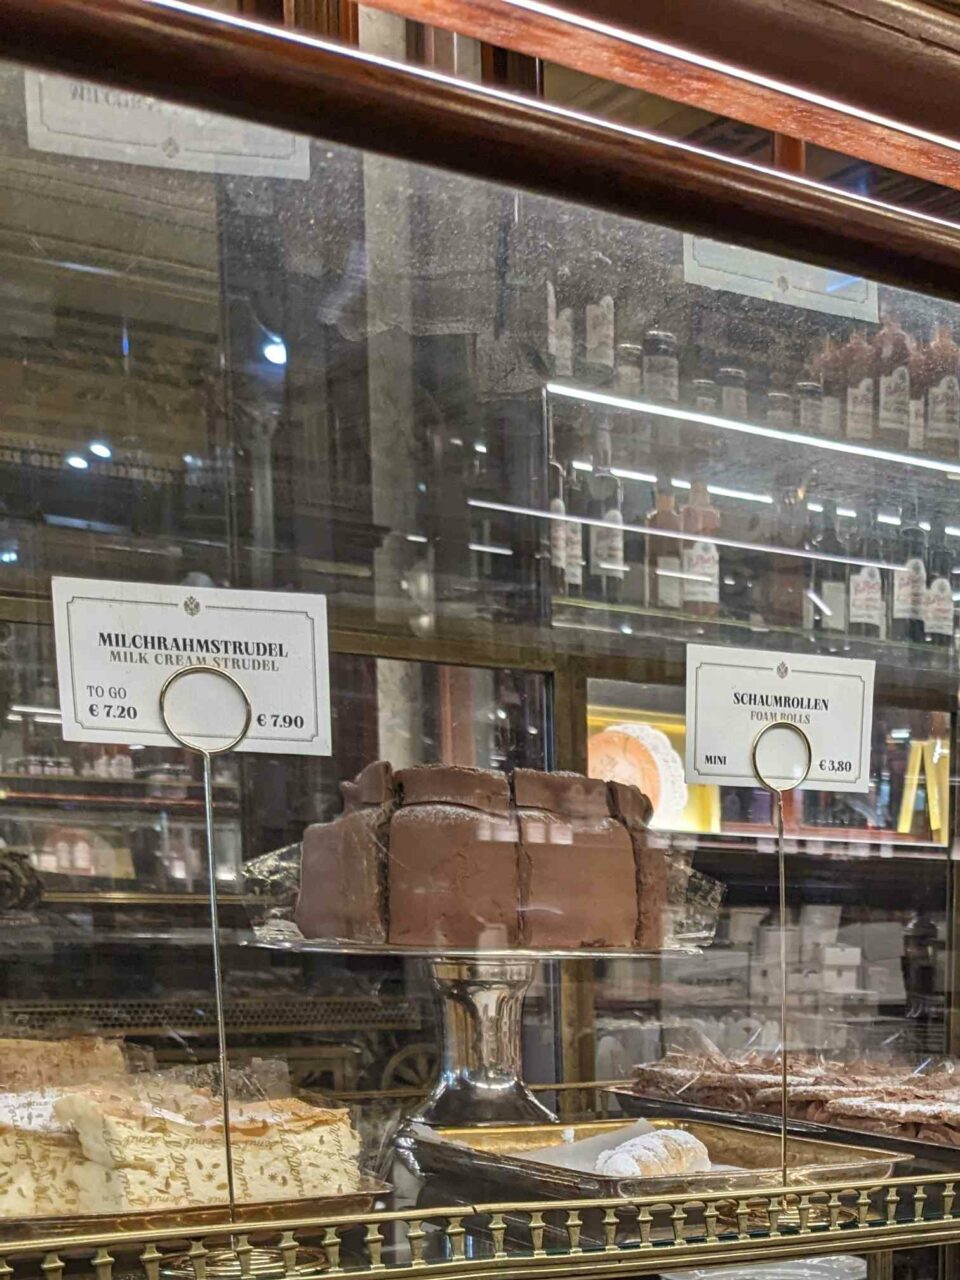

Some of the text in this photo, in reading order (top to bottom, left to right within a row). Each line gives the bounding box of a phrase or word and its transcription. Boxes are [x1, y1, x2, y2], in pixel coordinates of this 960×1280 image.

[98, 632, 289, 658] MILCHRAHMSTRUDEL
[109, 650, 280, 672] MILK CREAM STRUDEL
[86, 685, 127, 700] TO GO
[733, 692, 829, 711] SCHAUMROLLEN
[88, 704, 138, 720] € 7.20
[750, 711, 811, 724] FOAM ROLLS
[256, 714, 305, 729] € 7.90
[704, 755, 727, 765] MINI
[828, 760, 852, 773] 3,80
